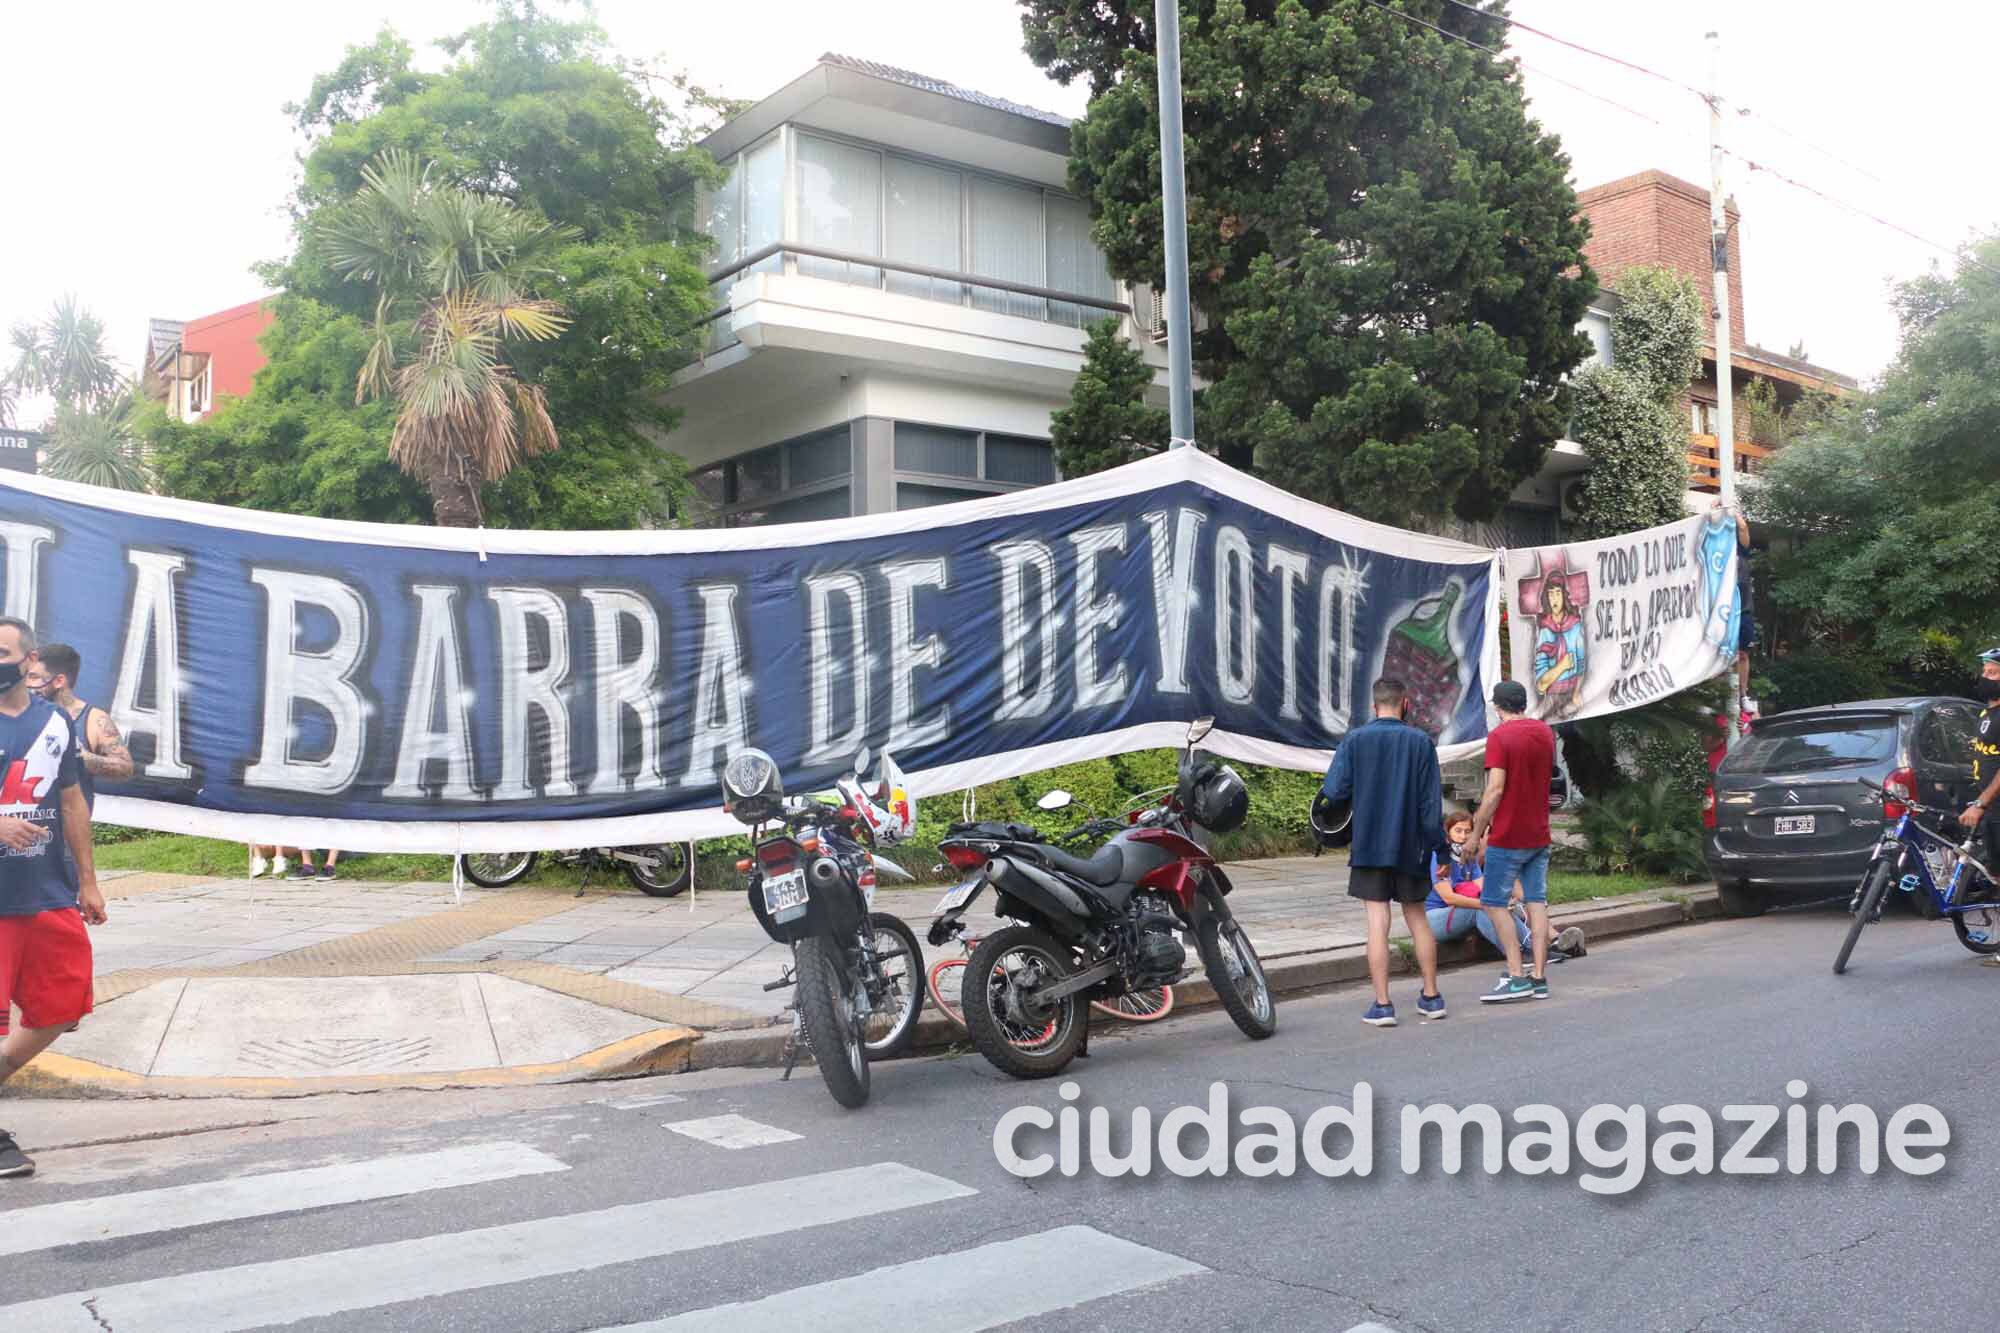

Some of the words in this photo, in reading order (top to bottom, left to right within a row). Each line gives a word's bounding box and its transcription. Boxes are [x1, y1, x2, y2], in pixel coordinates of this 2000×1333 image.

[0, 436, 28, 448] na
[1597, 544, 1639, 589] TODO
[1643, 539, 1660, 579] LO
[1664, 533, 1686, 573] QUE
[1621, 598, 1641, 638] LO
[243, 566, 754, 804] BARRA
[804, 556, 952, 766] DE
[988, 507, 1358, 735] DEVOTO
